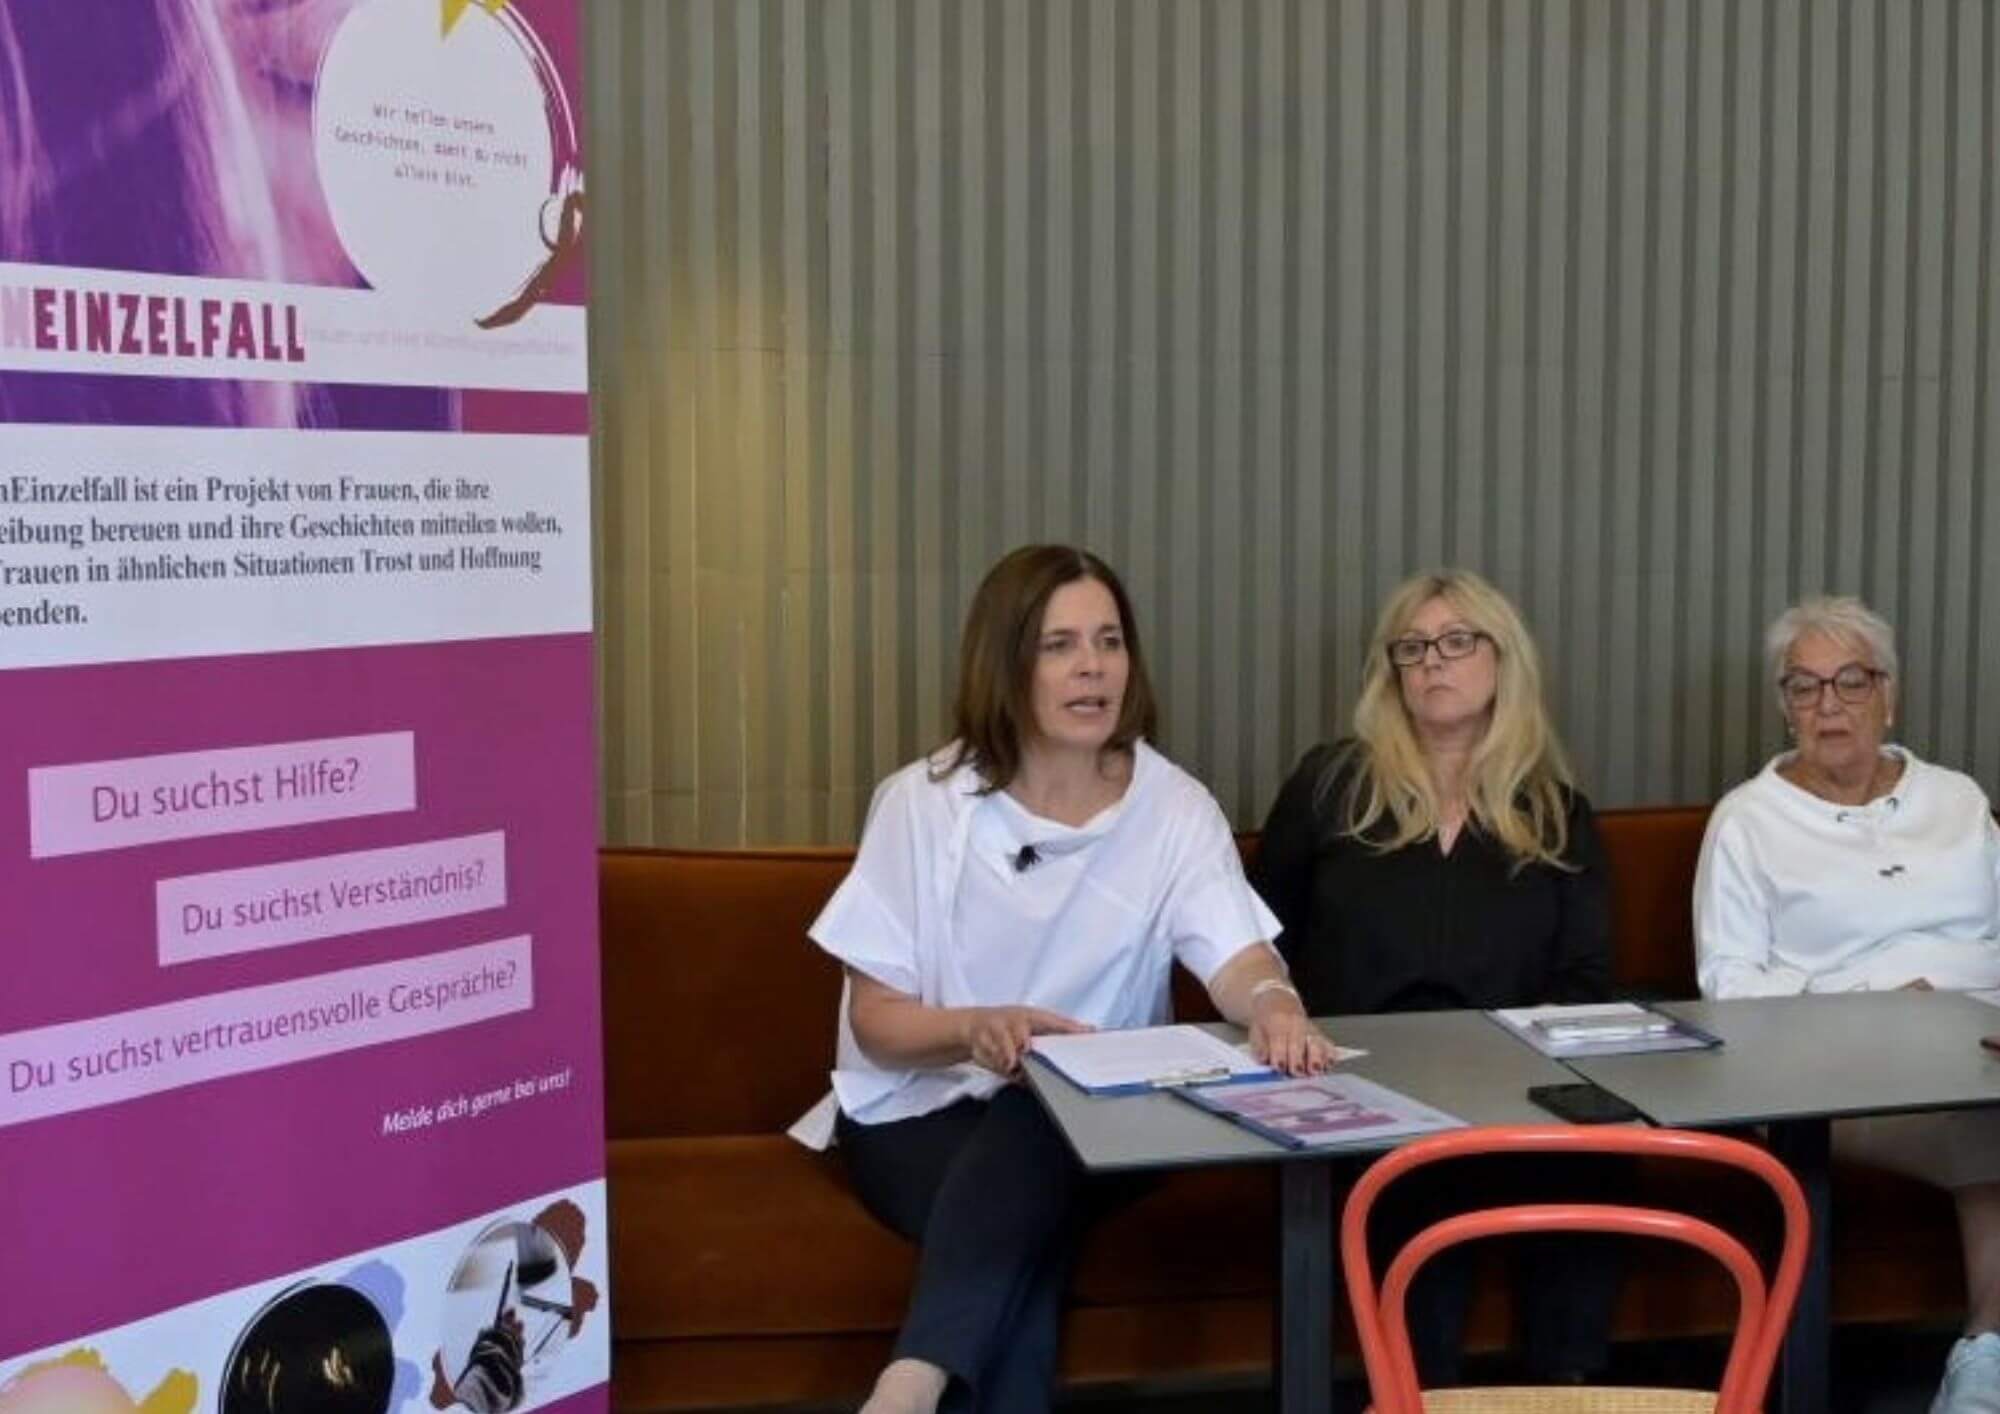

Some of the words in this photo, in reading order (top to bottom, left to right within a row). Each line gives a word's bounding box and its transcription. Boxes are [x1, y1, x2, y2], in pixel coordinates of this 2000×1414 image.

[134, 477, 158, 502] ist
[164, 477, 198, 502] ein
[206, 476, 290, 507] Projekt
[297, 483, 332, 501] von
[339, 477, 420, 503] Frauen,
[423, 479, 452, 500] die
[456, 479, 490, 500] ihre
[91, 517, 181, 542] bereuen
[188, 515, 233, 539] und
[241, 515, 284, 539] ihre
[290, 513, 415, 538] Geschichten
[421, 513, 497, 536] mitteilen
[501, 512, 563, 536] wollen,
[0, 558, 79, 585] rauen
[87, 557, 110, 582] in
[117, 554, 227, 582] ähnlichen
[233, 550, 355, 578] Situationen
[360, 548, 412, 573] Trost
[418, 548, 455, 571] und
[460, 546, 541, 572] Hoffnung
[0, 599, 87, 627] enden.
[92, 786, 139, 823] Du
[152, 770, 264, 815] suchst
[276, 757, 360, 800] Hilfe?
[182, 903, 222, 935] Du
[234, 889, 323, 927] suchst
[330, 859, 486, 909] Verständnis?
[10, 1060, 54, 1093] Du
[68, 1037, 163, 1082] suchst
[172, 992, 380, 1057] vertrauensvolle
[389, 960, 516, 1012] Gespräche?
[383, 1106, 433, 1135] Melde
[437, 1094, 468, 1123] dich
[471, 1086, 512, 1117] gerne
